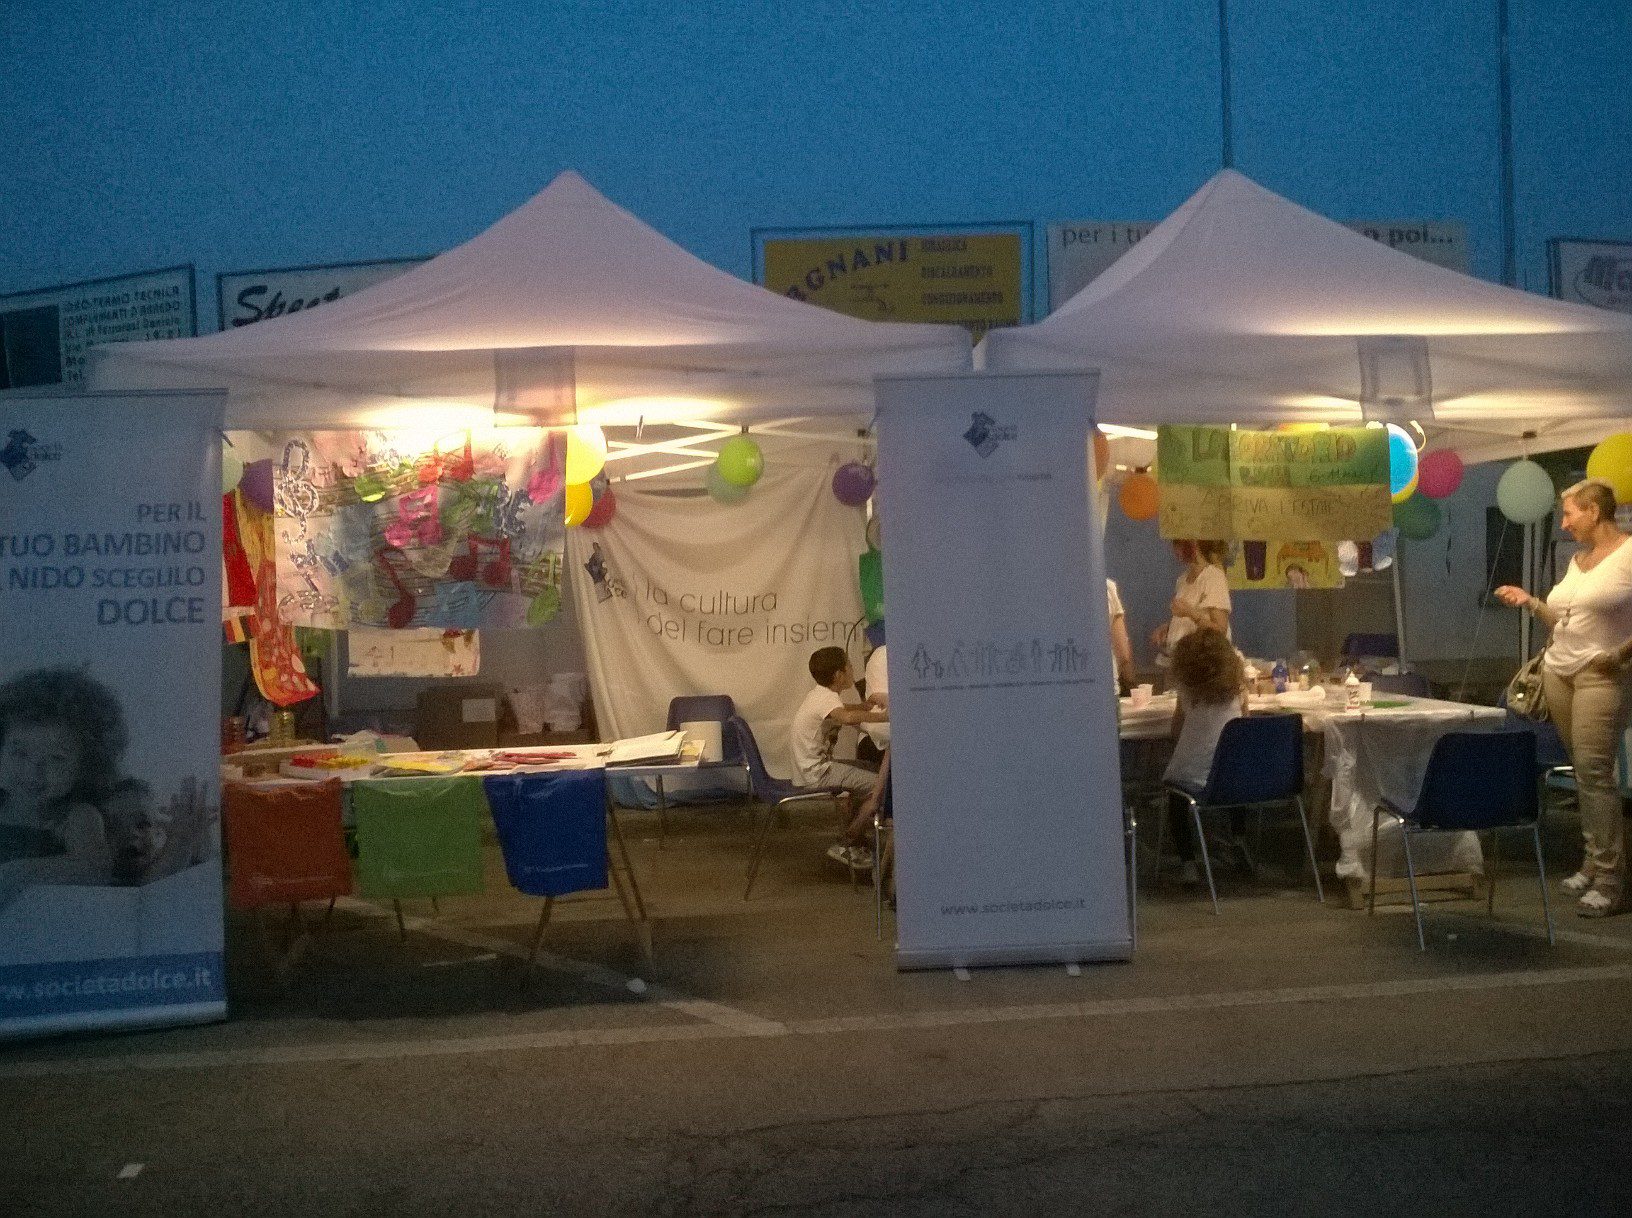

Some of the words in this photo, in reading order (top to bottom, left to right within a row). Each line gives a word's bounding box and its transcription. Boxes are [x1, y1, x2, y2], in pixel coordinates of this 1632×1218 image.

[1062, 227, 1102, 250] per
[137, 502, 181, 523] PER
[187, 500, 206, 521] IL
[63, 530, 206, 556] BAMBINO
[8, 565, 85, 591] NIDO
[645, 577, 669, 606] la
[679, 588, 778, 616] cultura
[97, 596, 205, 626] DOLCE
[647, 611, 686, 643] del
[697, 622, 754, 647] fare
[766, 612, 858, 645] insiem
